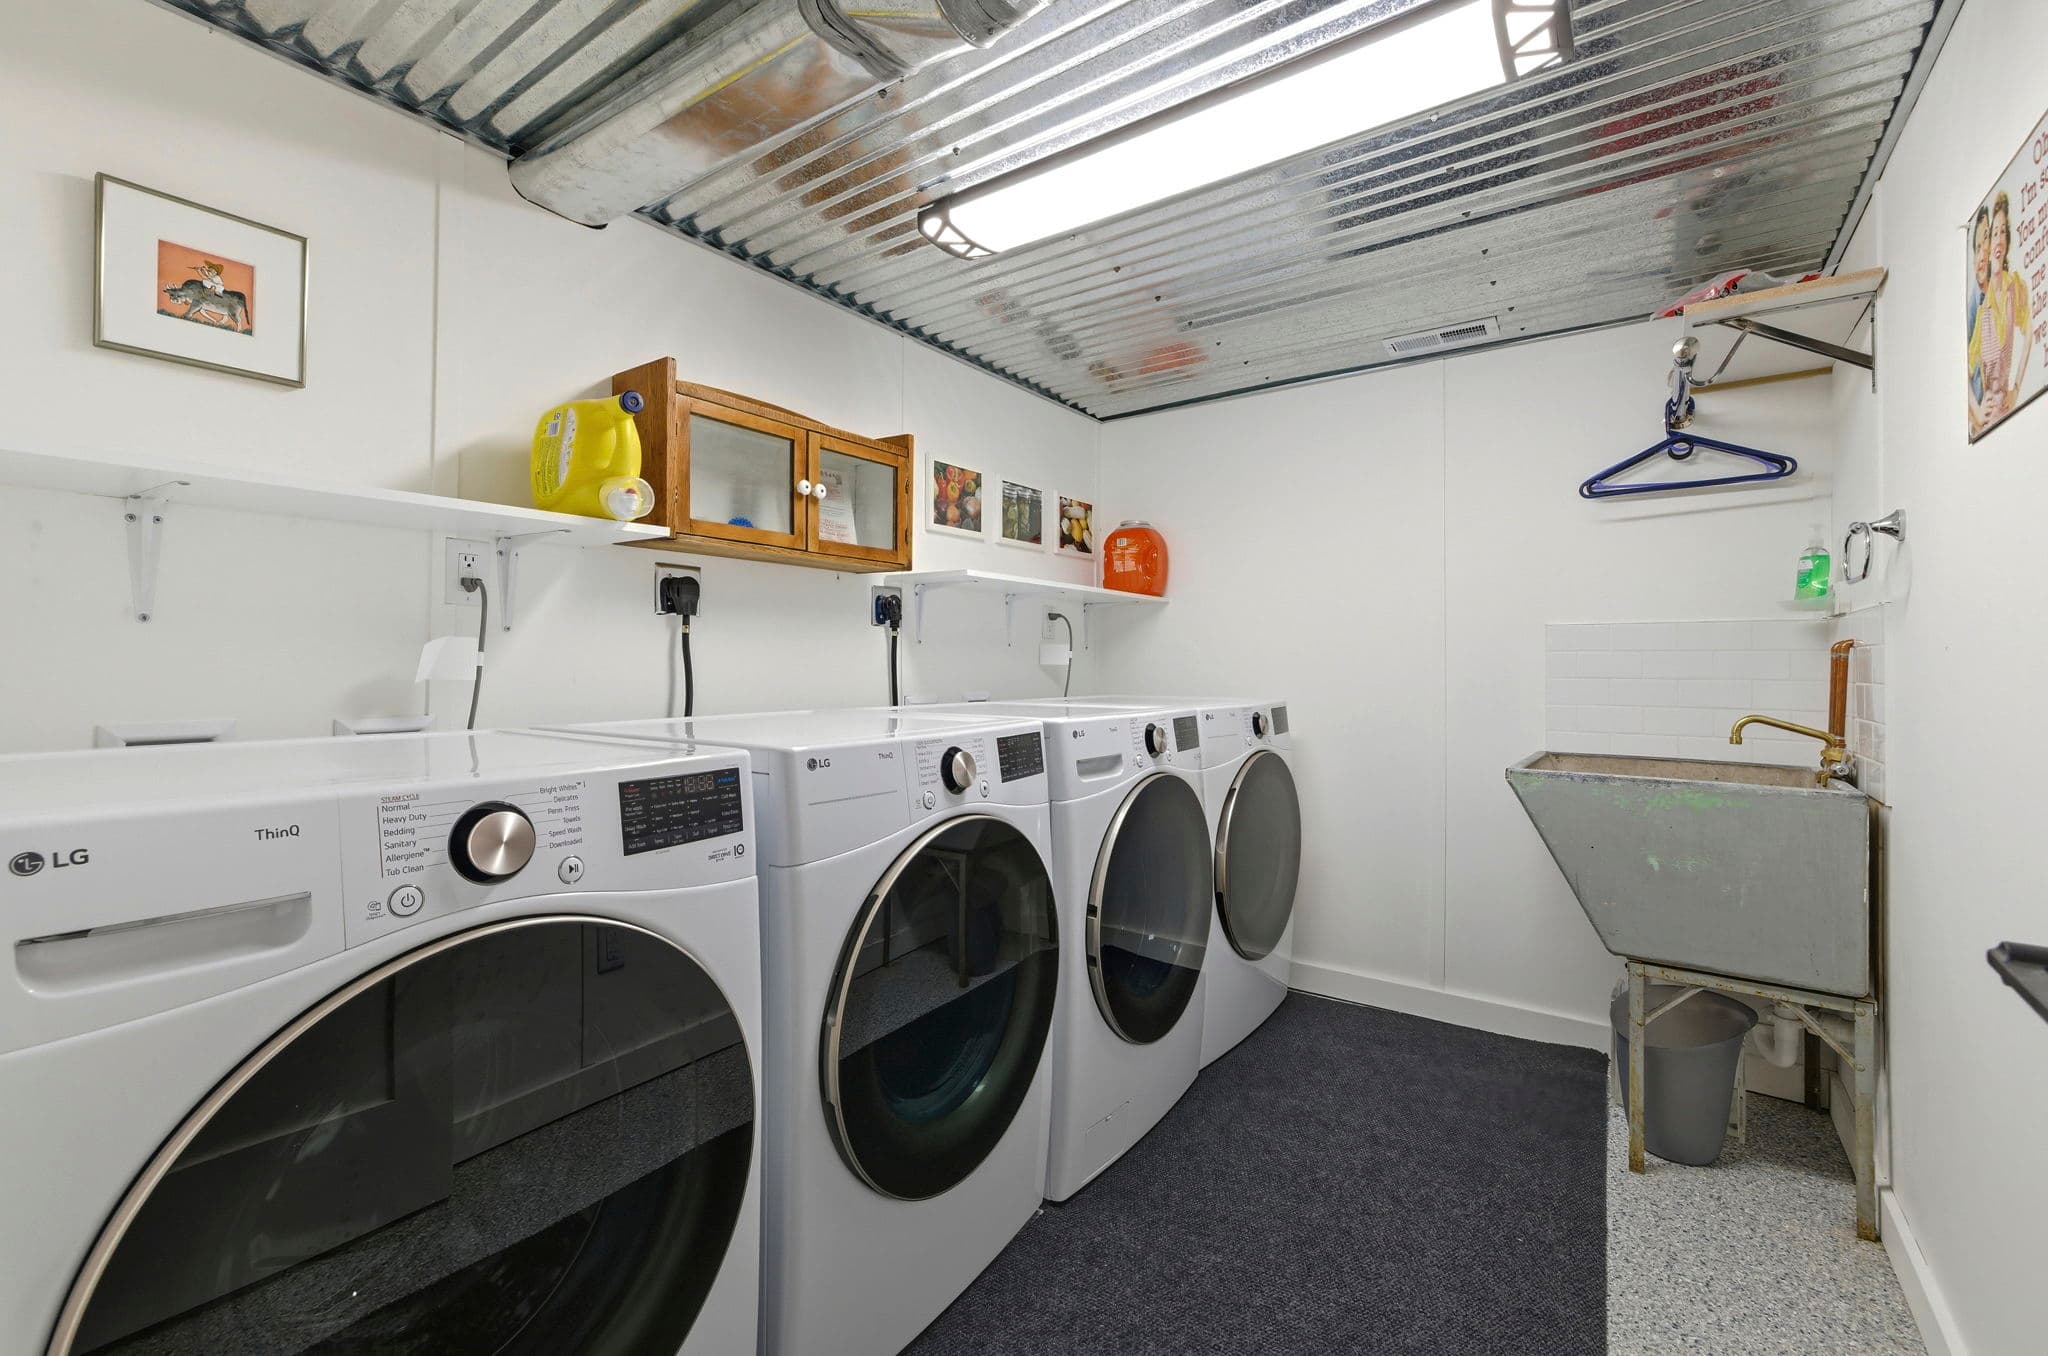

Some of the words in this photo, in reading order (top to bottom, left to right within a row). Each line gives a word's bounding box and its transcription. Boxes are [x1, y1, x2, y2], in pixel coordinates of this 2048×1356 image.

[2016, 215, 2035, 248] You
[2032, 263, 2045, 291] me
[2032, 290, 2048, 319] the
[818, 758, 831, 769] LG
[381, 803, 411, 813] Normal
[382, 816, 407, 825] Heavy
[408, 813, 428, 823] Duty
[253, 823, 301, 842] ThinQ
[383, 827, 416, 838] Bedding
[384, 839, 417, 851] Sanitary
[549, 837, 583, 849] Downloaded
[52, 848, 90, 869] LG
[385, 867, 401, 877] Tub
[402, 864, 424, 874] Clean
